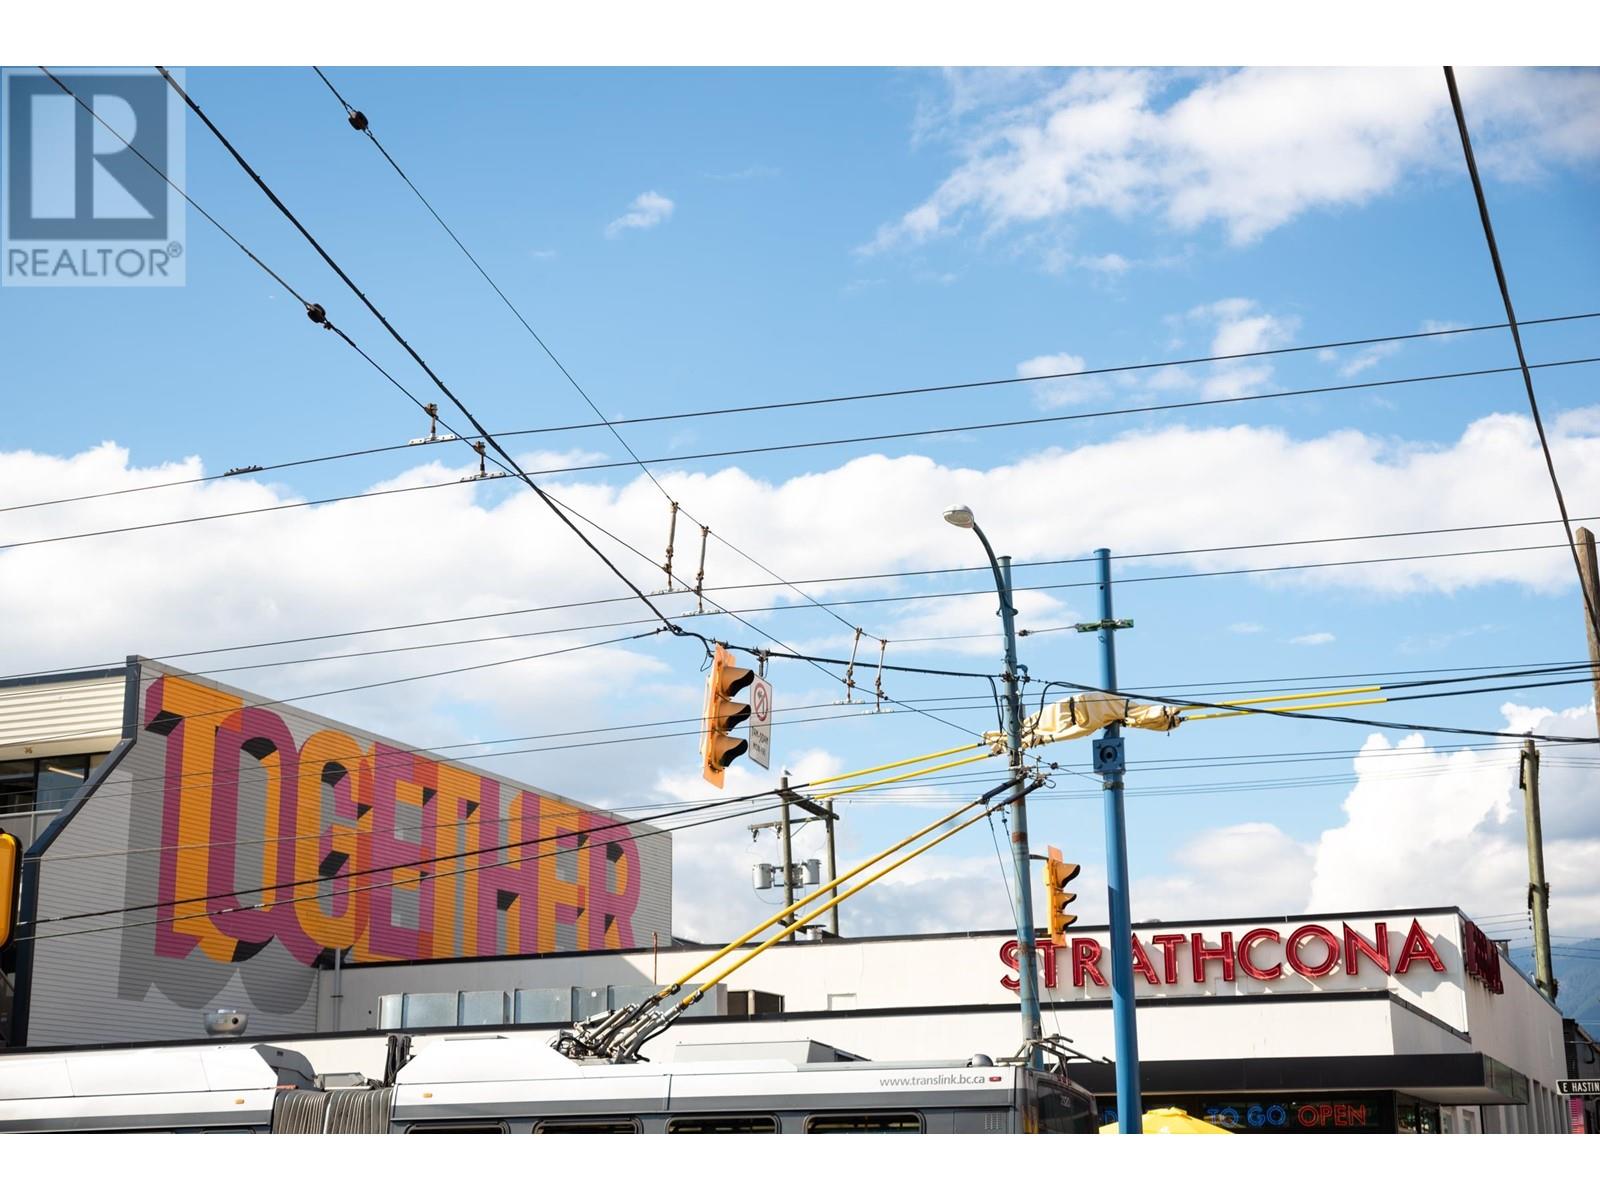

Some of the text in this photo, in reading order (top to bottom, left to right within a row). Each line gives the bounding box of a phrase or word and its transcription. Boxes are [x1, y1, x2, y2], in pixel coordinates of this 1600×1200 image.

[144, 674, 641, 967] TOGETHER
[879, 1075, 985, 1087] www.translink.bc.ca
[1562, 1082, 1568, 1092] E
[1206, 1104, 1367, 1128] TO GO OPEN
